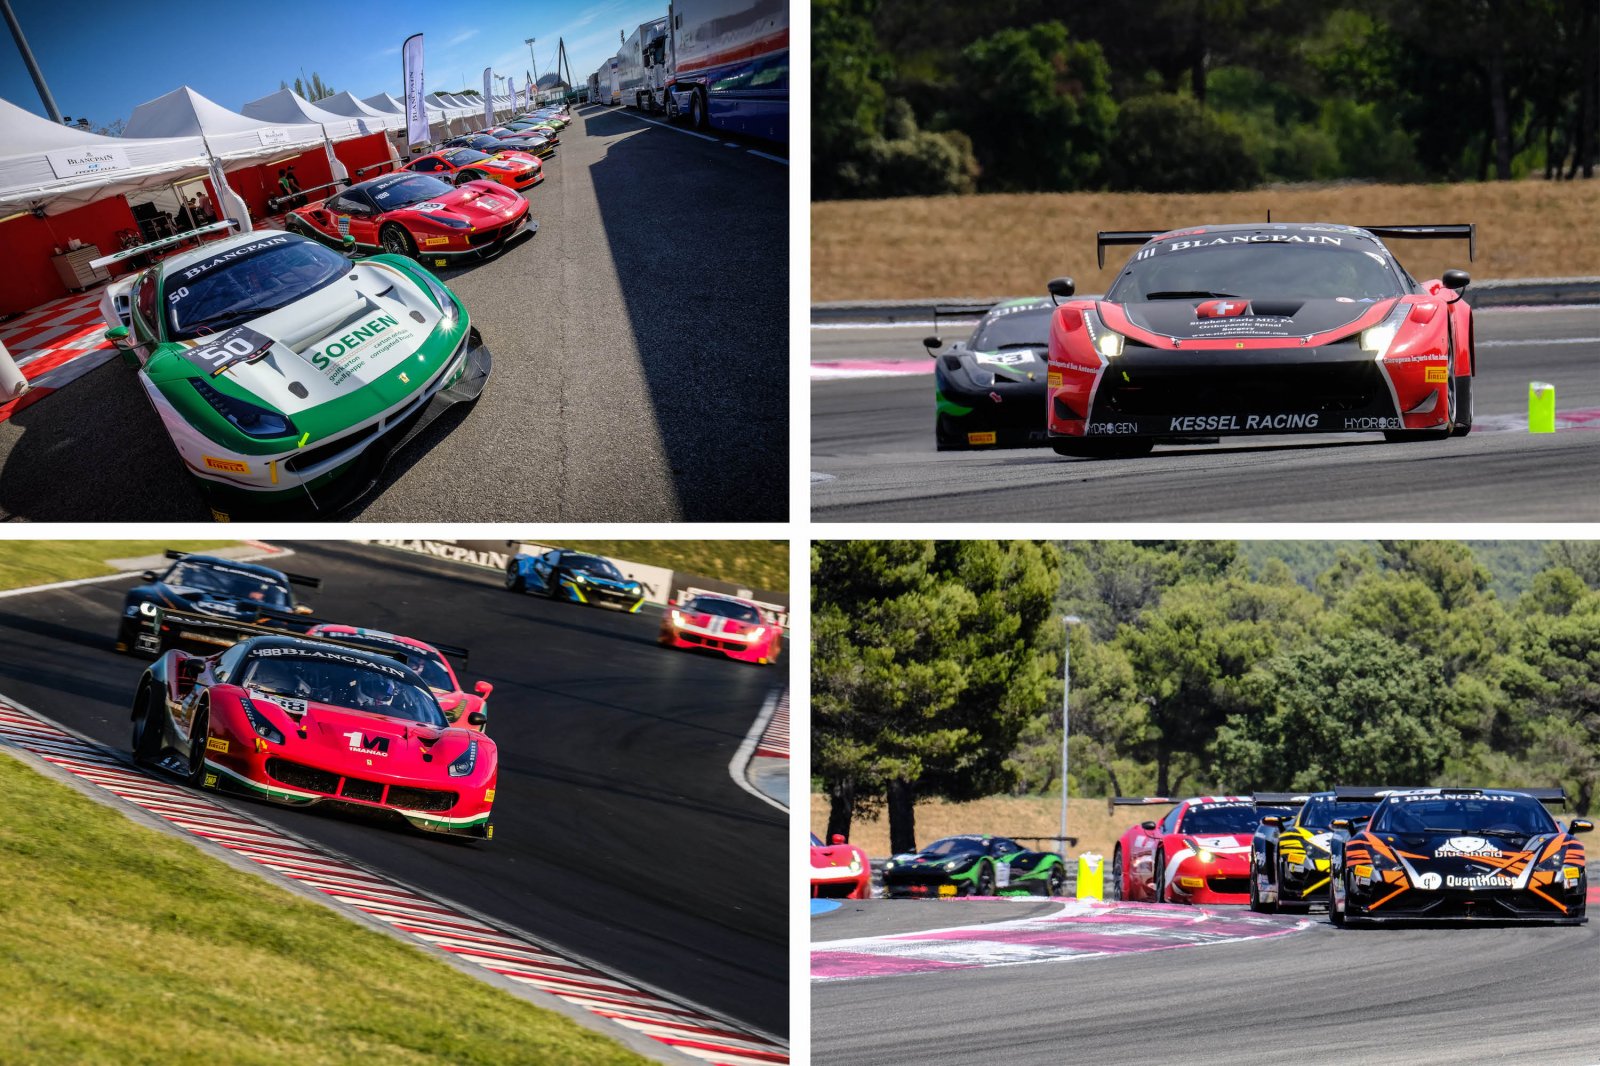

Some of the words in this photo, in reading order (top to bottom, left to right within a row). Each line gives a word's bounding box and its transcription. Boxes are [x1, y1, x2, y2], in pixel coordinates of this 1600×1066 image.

[67, 154, 113, 165] BLANCPAIN
[1169, 234, 1344, 252] BLANCPAIN
[184, 236, 289, 280] BLANCPAIN
[168, 286, 190, 305] 50
[311, 315, 399, 371] SOENEN
[198, 338, 254, 367] 50
[1170, 415, 1240, 431] KESSEL
[1246, 413, 1319, 429] RACING
[206, 458, 246, 472] PIRELLI
[252, 648, 282, 657] 488
[281, 648, 405, 678] BLANCPAIN
[208, 740, 227, 751] PIRELLI
[1405, 793, 1515, 803] BLANCPAIN
[1446, 874, 1518, 888] QuantHouse
